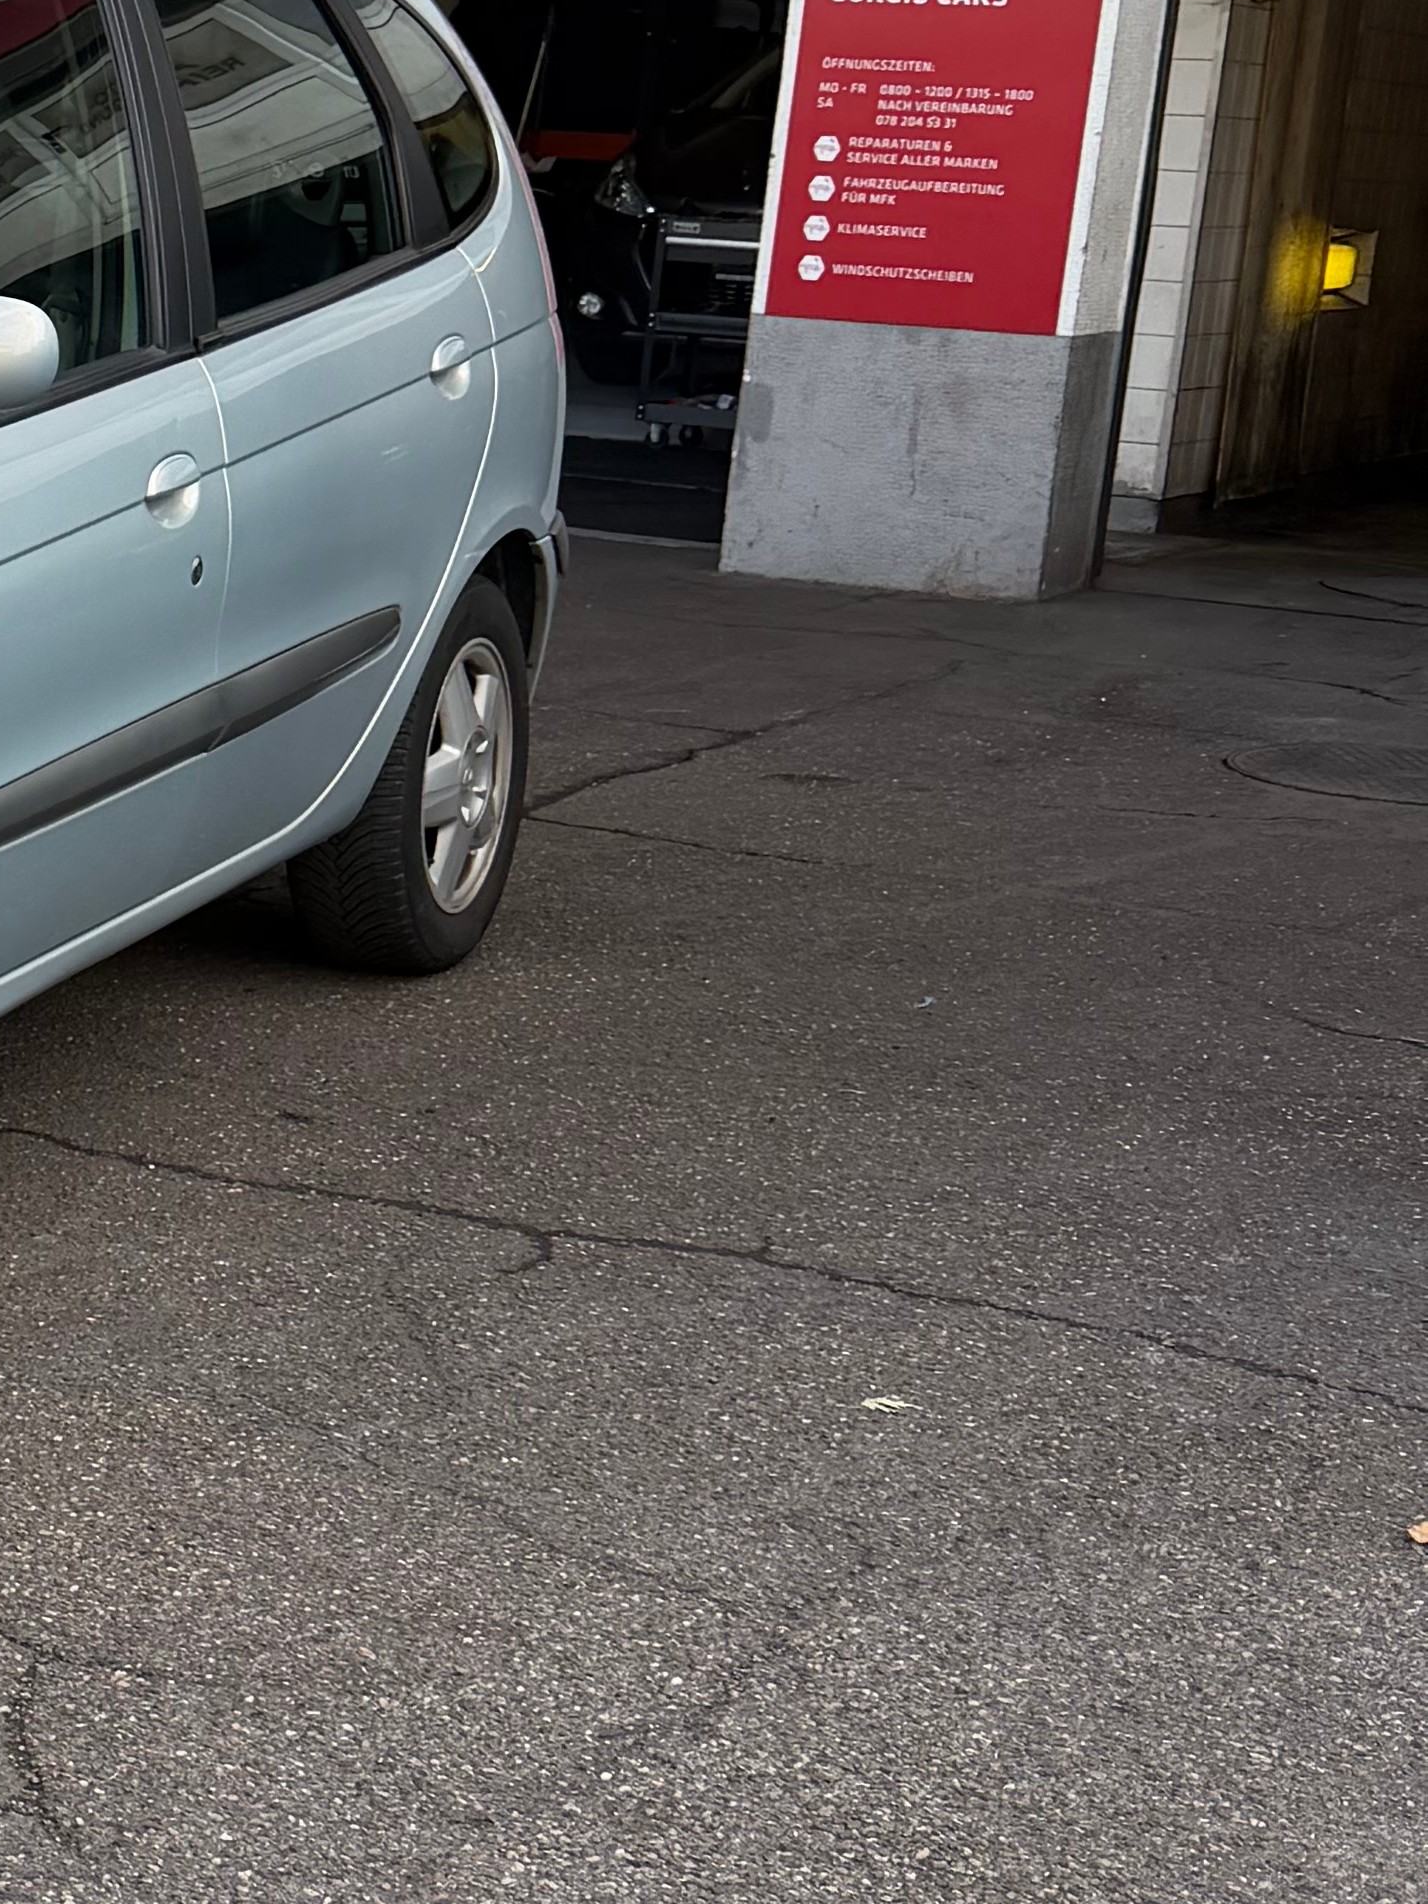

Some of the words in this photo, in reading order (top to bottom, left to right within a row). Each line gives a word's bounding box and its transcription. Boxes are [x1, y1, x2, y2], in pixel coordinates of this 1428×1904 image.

[819, 81, 839, 93] MO
[850, 83, 867, 94] FR
[879, 84, 912, 96] 0800
[924, 85, 952, 98] 1200
[966, 87, 991, 99] 1315
[1004, 89, 1034, 101] 1800
[816, 97, 834, 108] SA
[877, 99, 912, 112] NACH
[915, 101, 1014, 116] VEREINBARUNG
[848, 136, 941, 152] REPARATUREN
[846, 152, 898, 165] SERVICE
[900, 153, 940, 167] ALLER
[943, 156, 998, 170] MARKEN
[843, 176, 1005, 196] FAHRZEUGAUFBEREITUNG
[841, 190, 866, 204] FÜR
[869, 193, 896, 205] MFK
[837, 223, 927, 239] KLIMASERVICE
[832, 263, 974, 284] WINDSCHUTZSCHEIBEN
